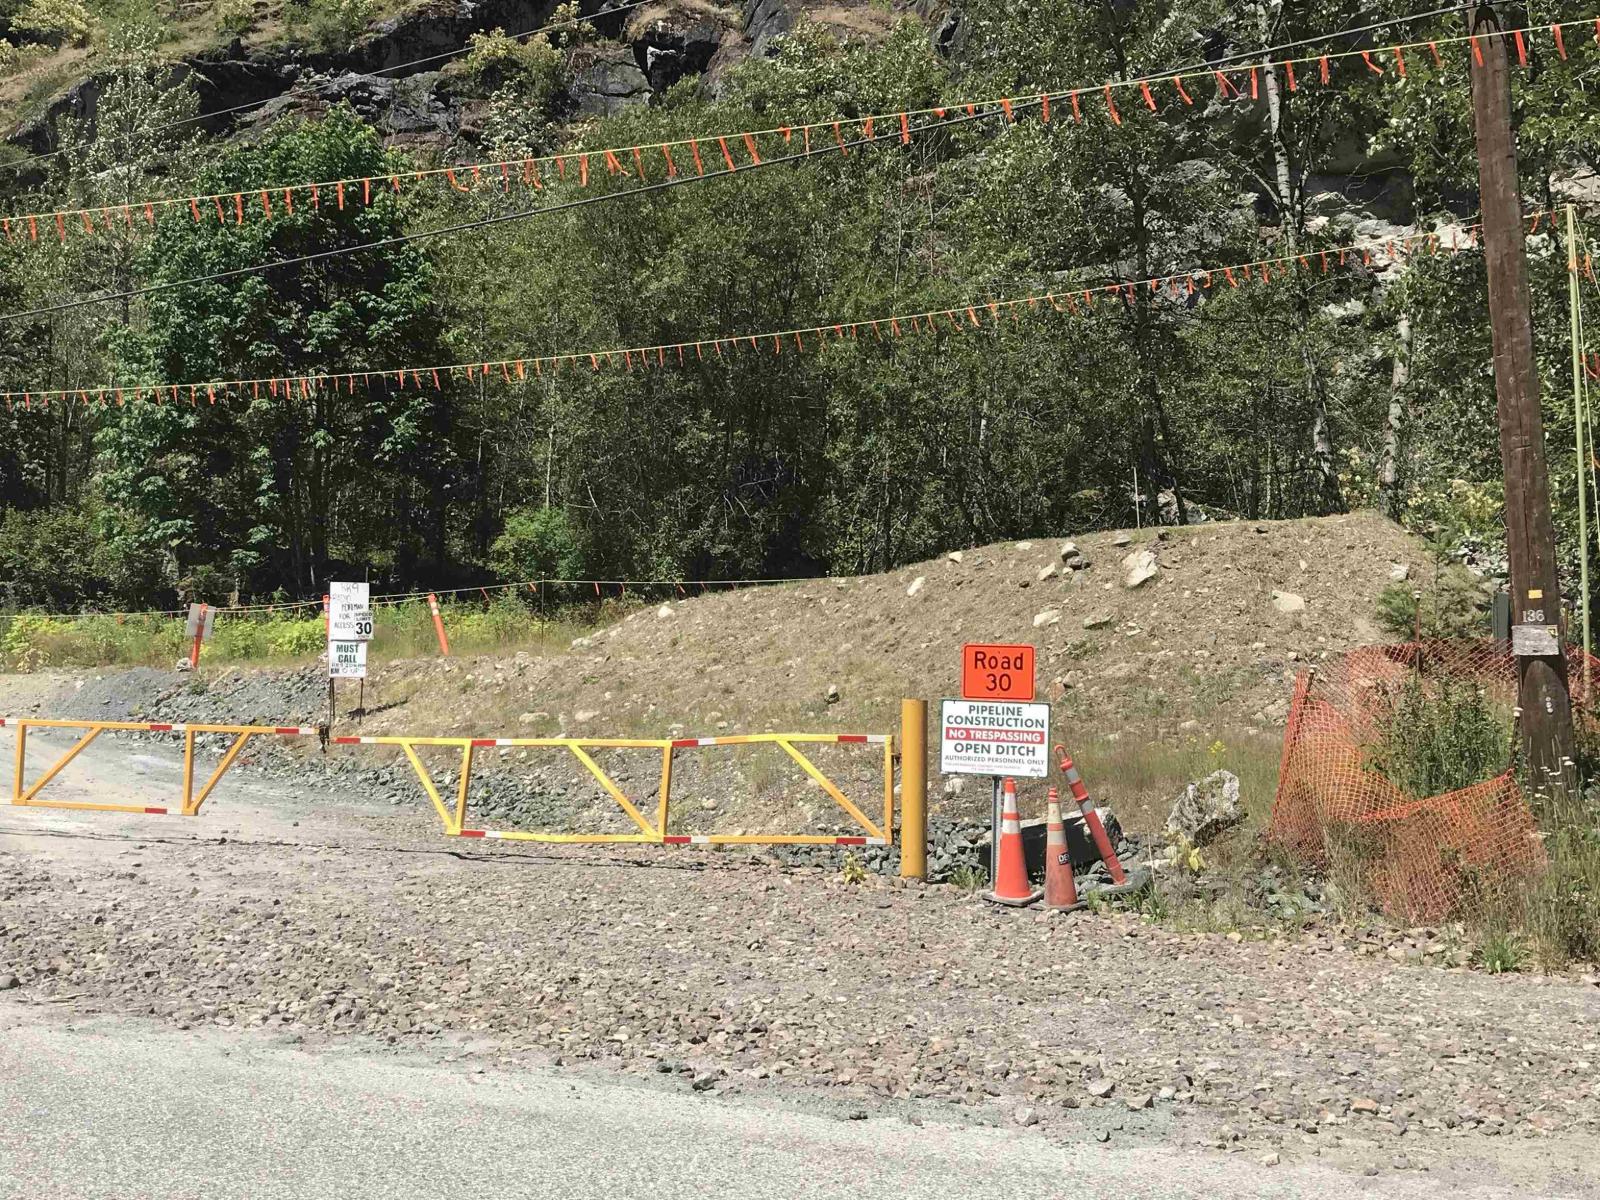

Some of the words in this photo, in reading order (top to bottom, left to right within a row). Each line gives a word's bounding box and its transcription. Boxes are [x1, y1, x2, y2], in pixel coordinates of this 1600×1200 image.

[1522, 610, 1545, 622] 136
[356, 622, 372, 634] 30
[336, 644, 358, 653] MUST
[338, 654, 357, 663] CALL
[974, 651, 1024, 670] Road
[986, 673, 1012, 692] 30
[968, 704, 1023, 716] PIPELINE
[946, 715, 1045, 728] CONSTRUCTION
[948, 729, 967, 739] NO
[970, 730, 1041, 742] TRESPASSING
[954, 742, 991, 754] OPEN
[996, 744, 1036, 757] DITCH
[988, 756, 1026, 764] PERSONNEL
